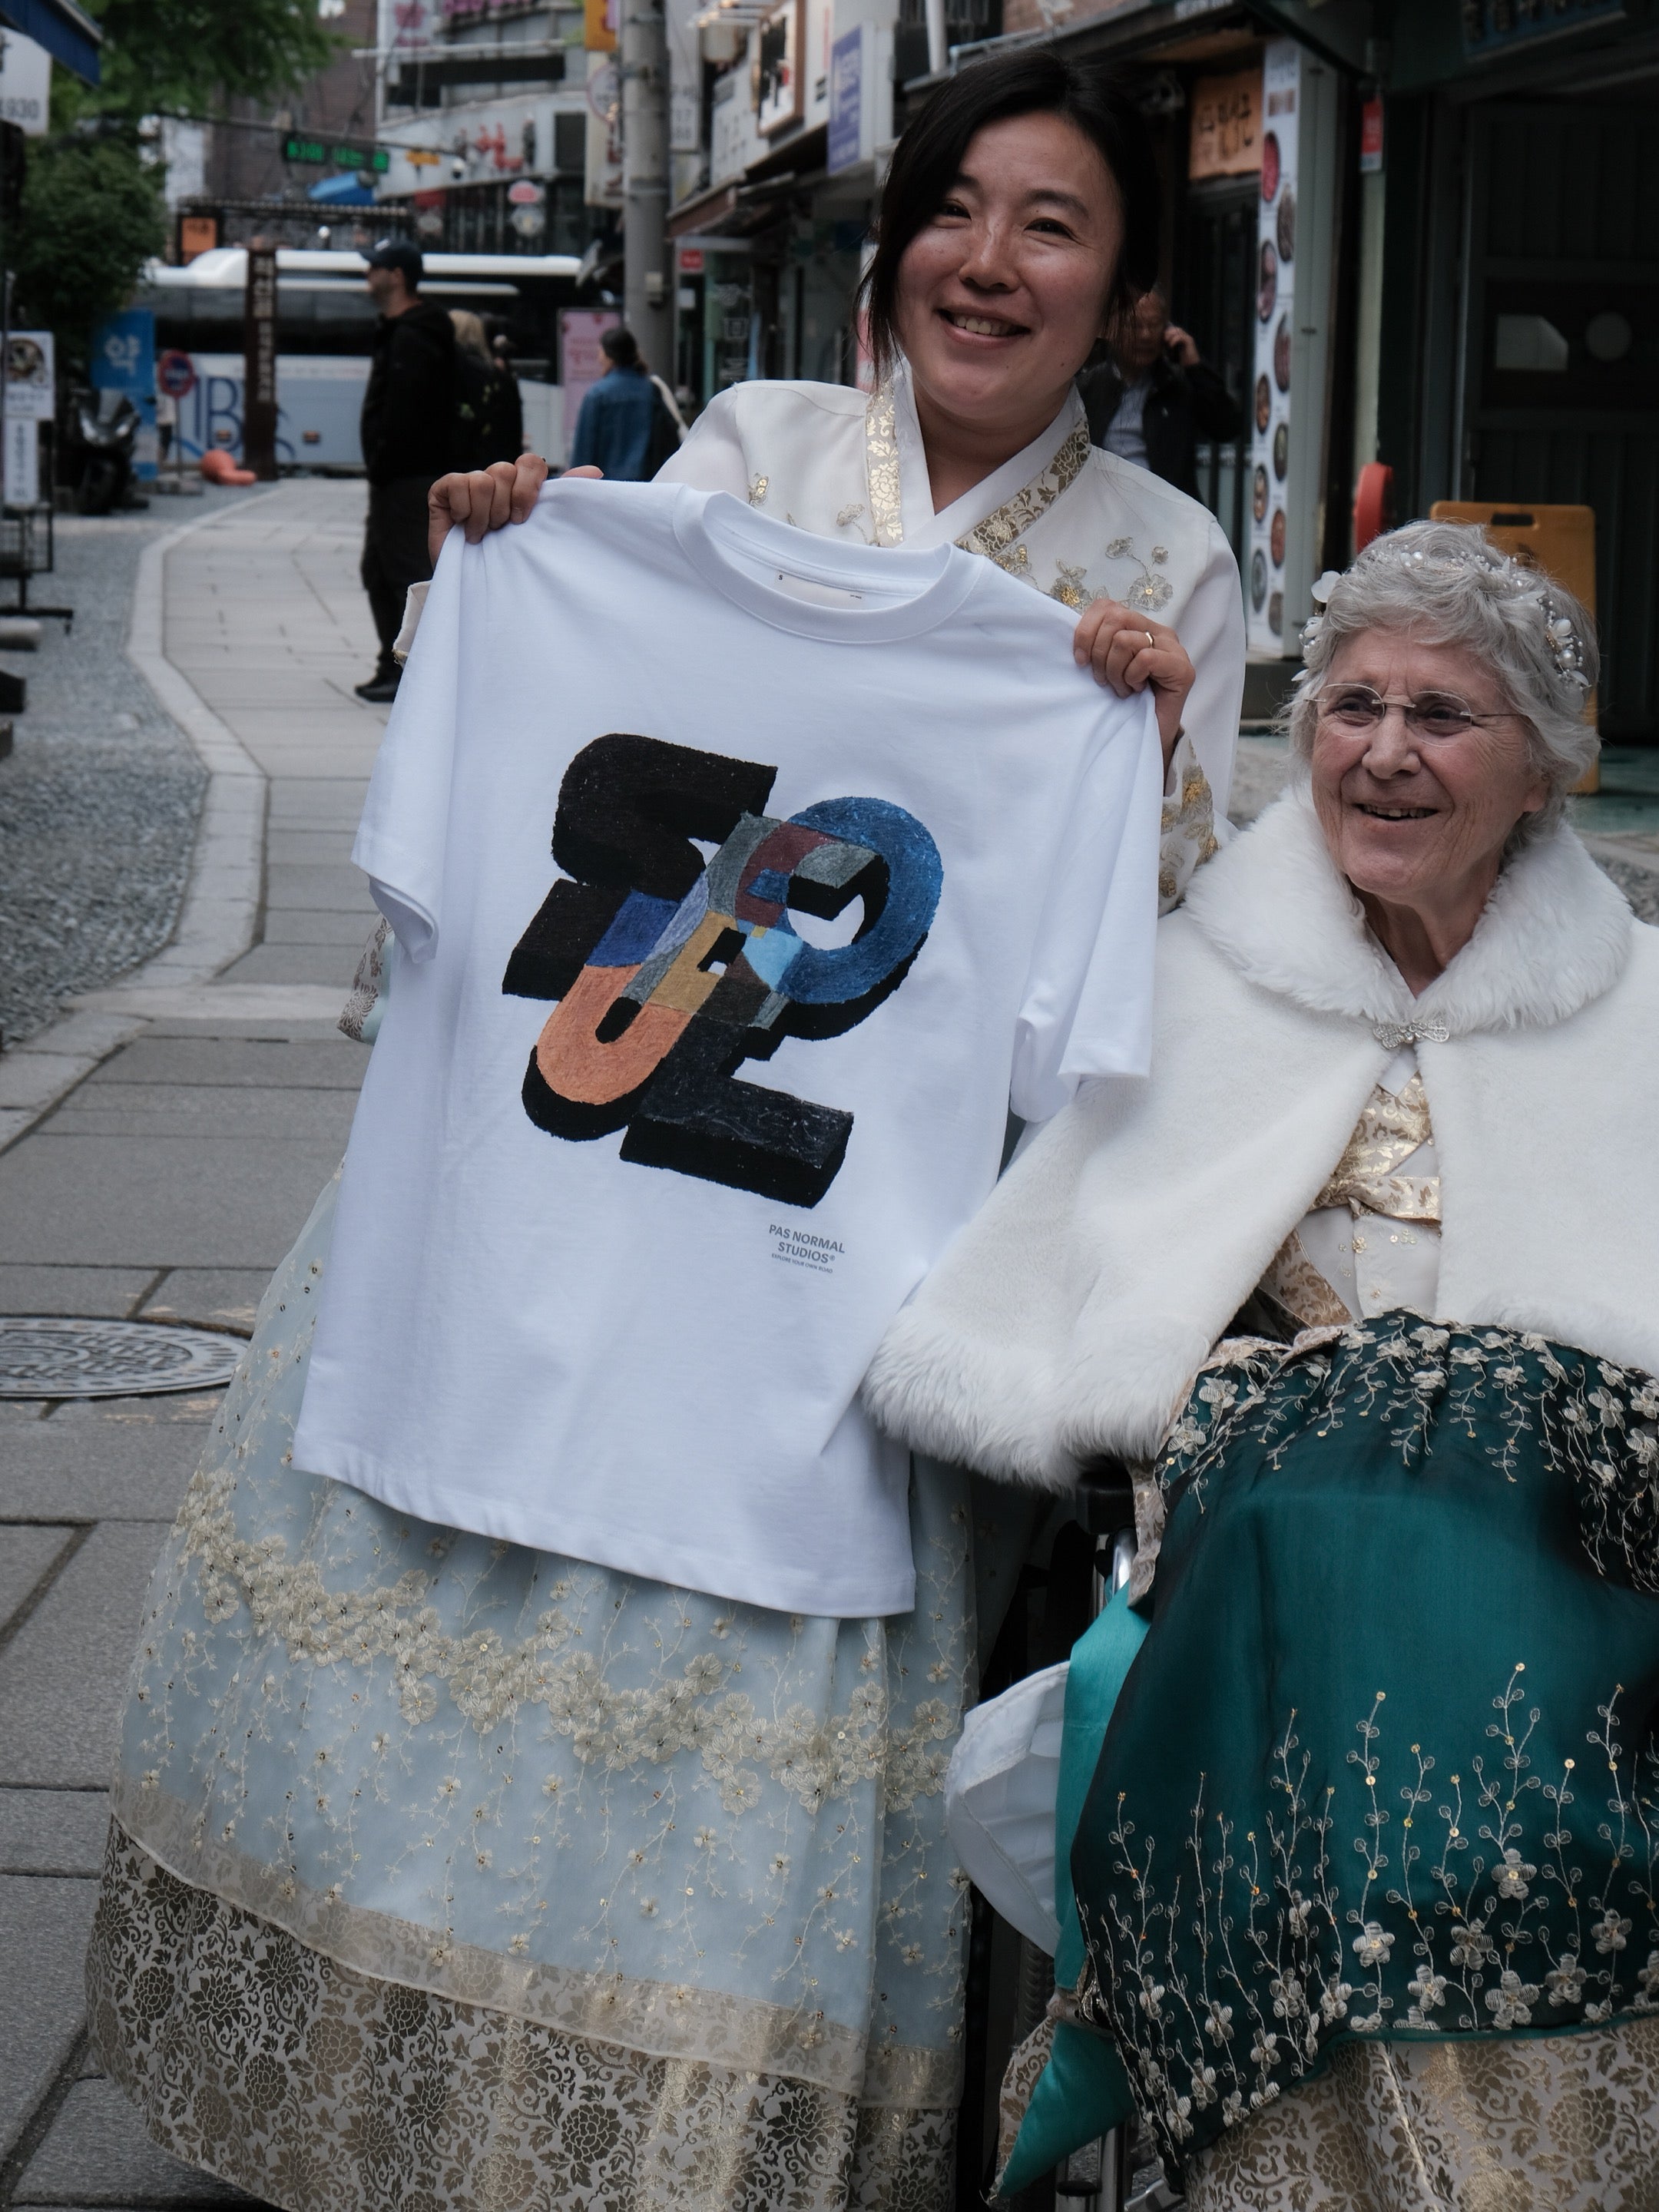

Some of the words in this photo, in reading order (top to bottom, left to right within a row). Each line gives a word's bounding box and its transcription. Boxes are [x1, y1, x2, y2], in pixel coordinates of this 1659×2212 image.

[104, 335, 142, 376] 약
[769, 1224, 791, 1239] PAS
[792, 1230, 846, 1253] NORMAL
